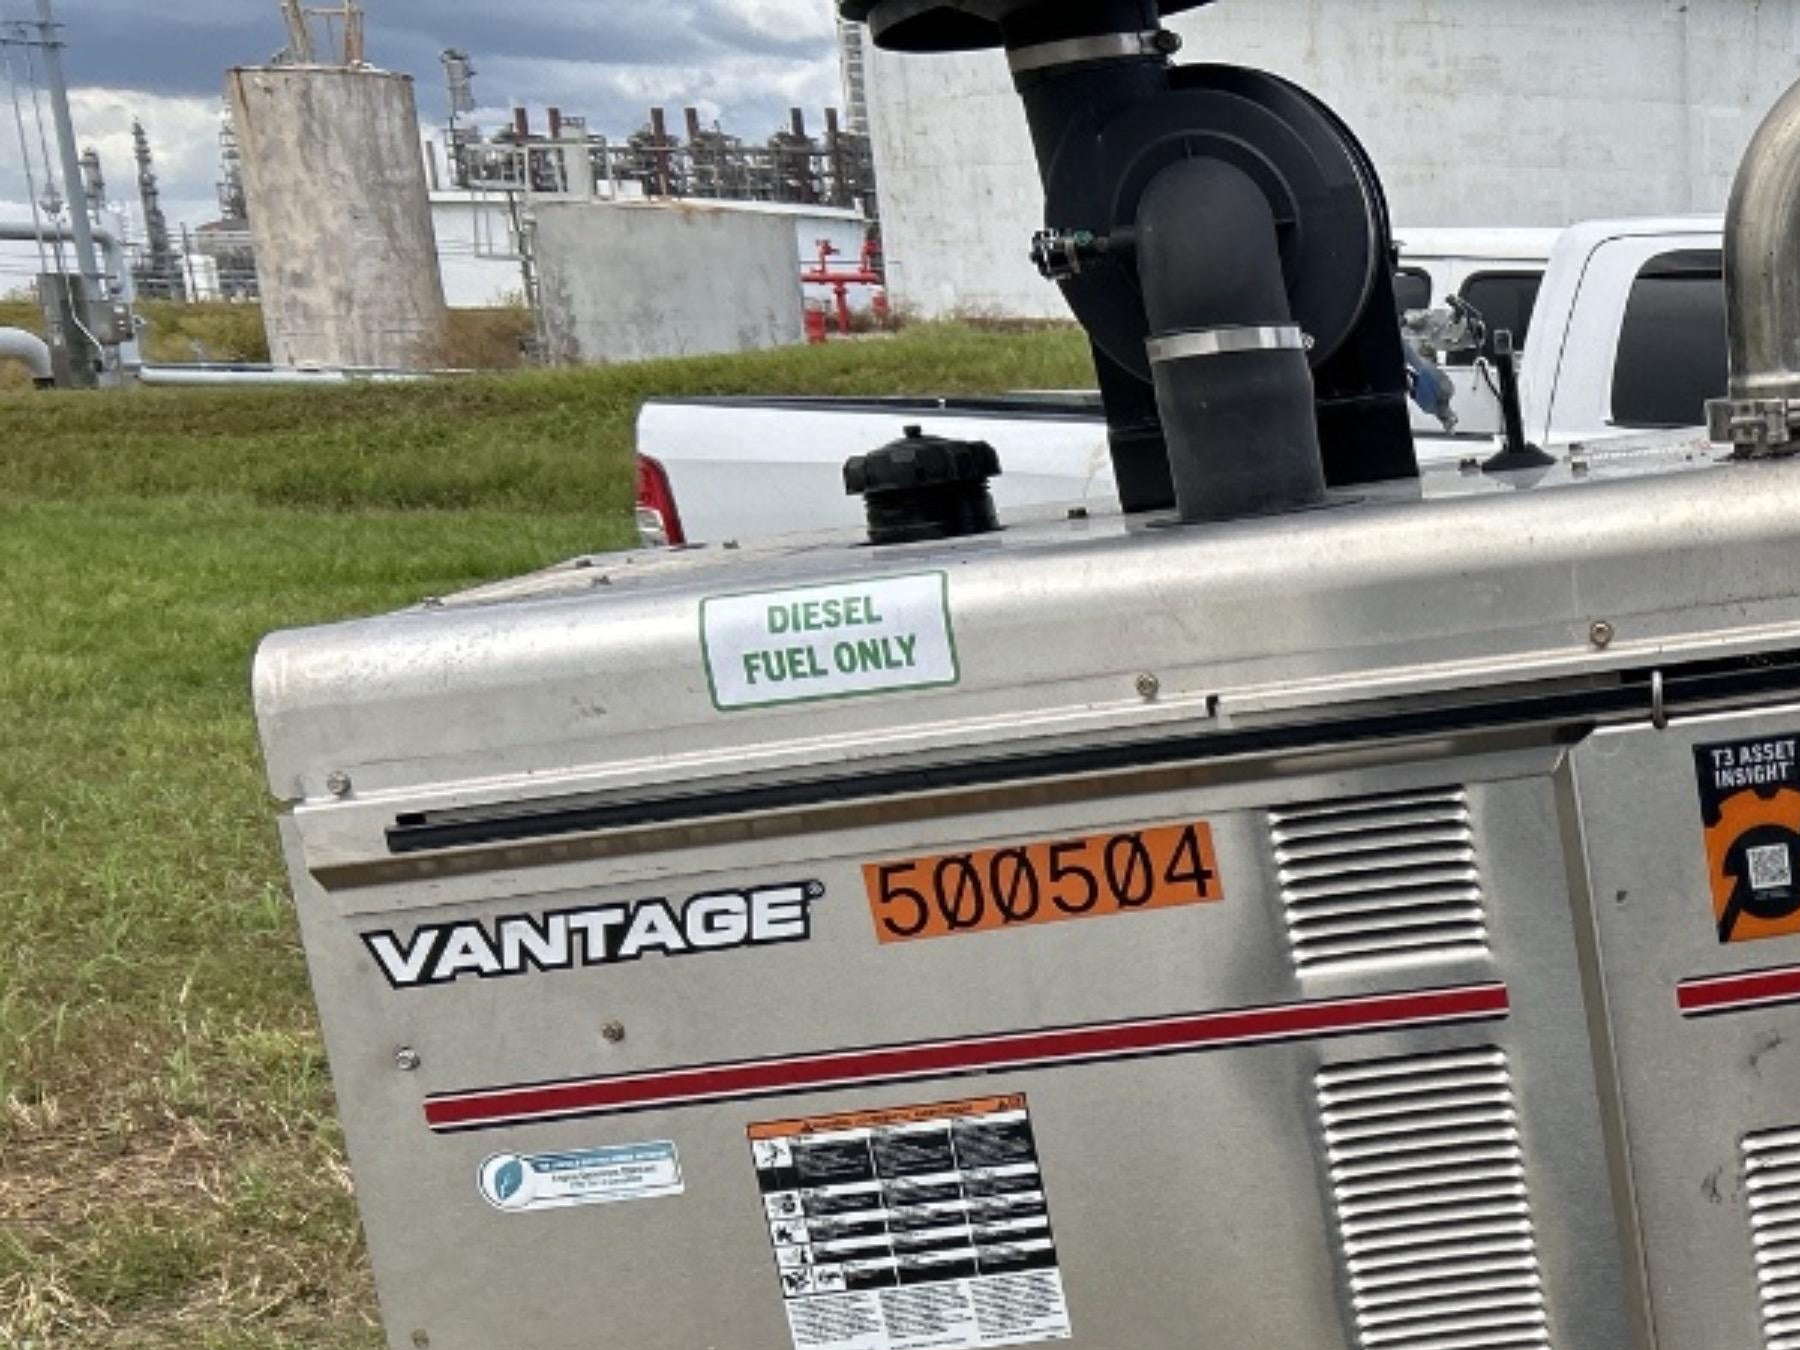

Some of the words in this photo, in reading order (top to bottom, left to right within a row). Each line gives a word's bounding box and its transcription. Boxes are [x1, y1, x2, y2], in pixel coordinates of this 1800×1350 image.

[767, 595, 883, 634] DIESEL
[742, 645, 829, 685] FUEL
[834, 634, 917, 673] ONLY
[1711, 748, 1735, 769] T3
[1739, 739, 1795, 766] ASSET
[1714, 762, 1789, 790] INSIGHT
[877, 823, 1213, 936] 500504
[361, 883, 812, 988] VANTAGE
